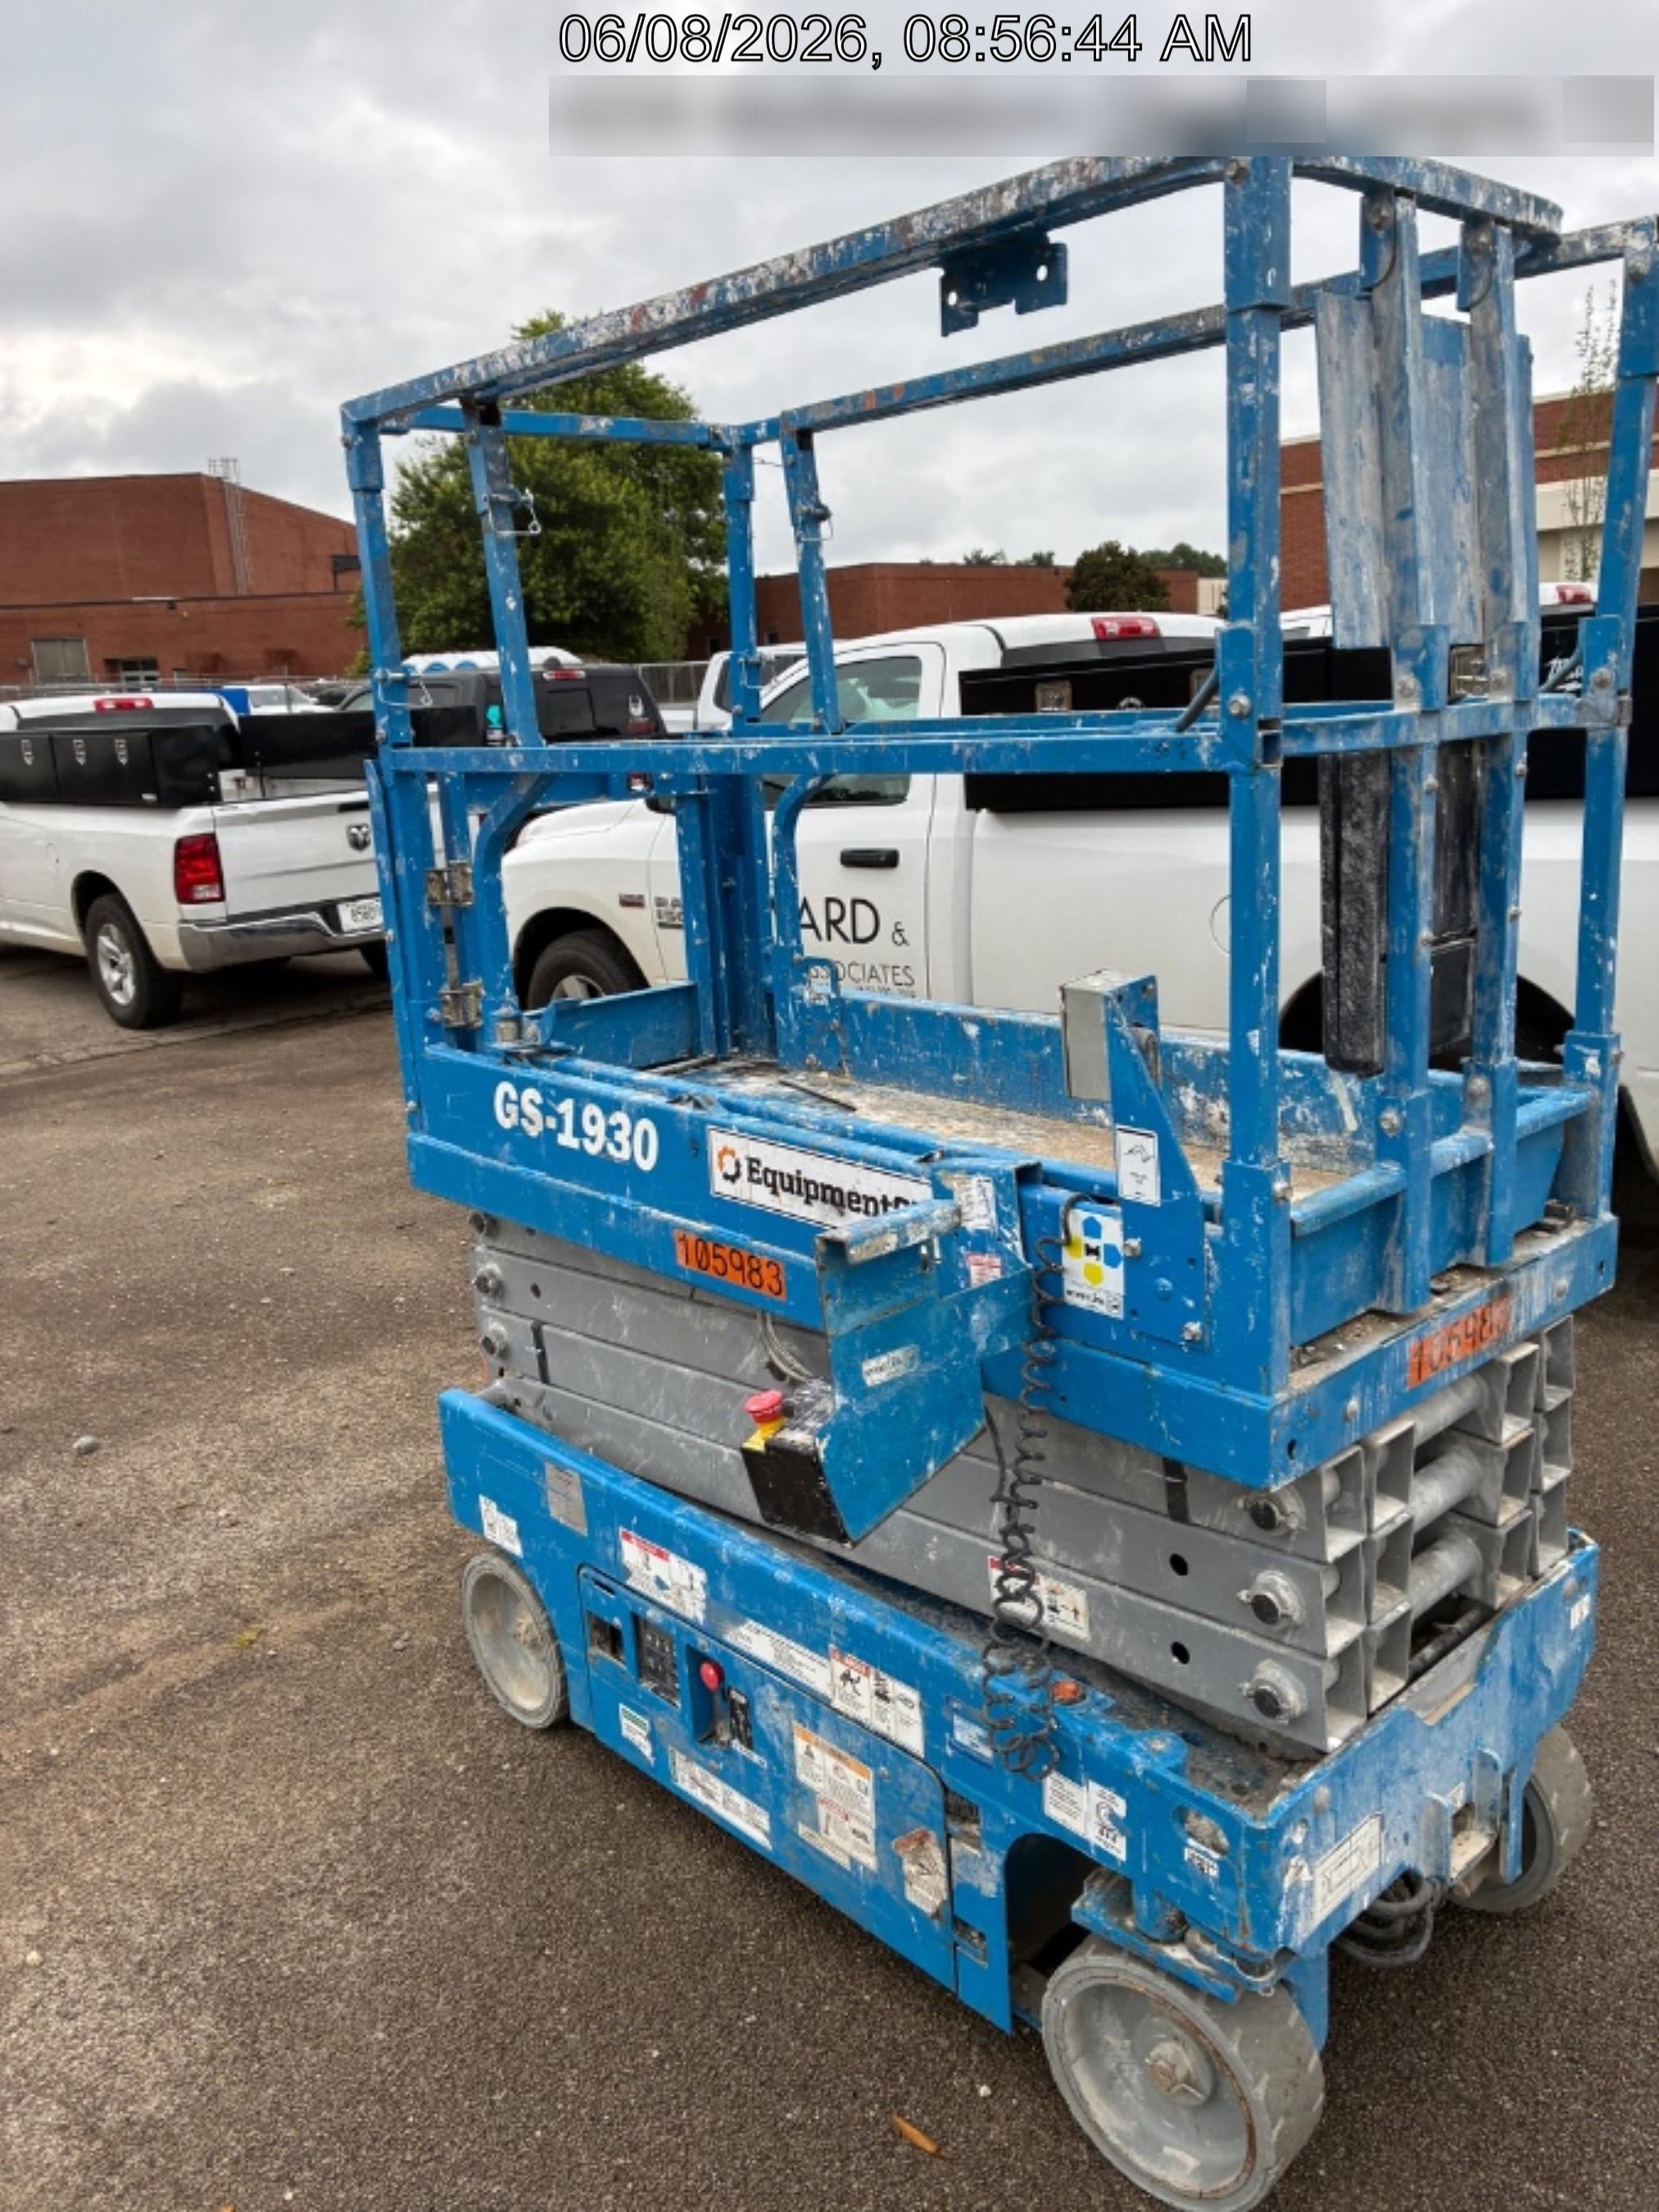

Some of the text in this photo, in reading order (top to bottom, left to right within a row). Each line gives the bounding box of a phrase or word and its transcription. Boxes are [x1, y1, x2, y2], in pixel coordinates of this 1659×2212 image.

[891, 921, 910, 946] &
[494, 1081, 659, 1171] GS-1930
[746, 1156, 916, 1216] Equipment
[676, 1233, 784, 1296] 105983
